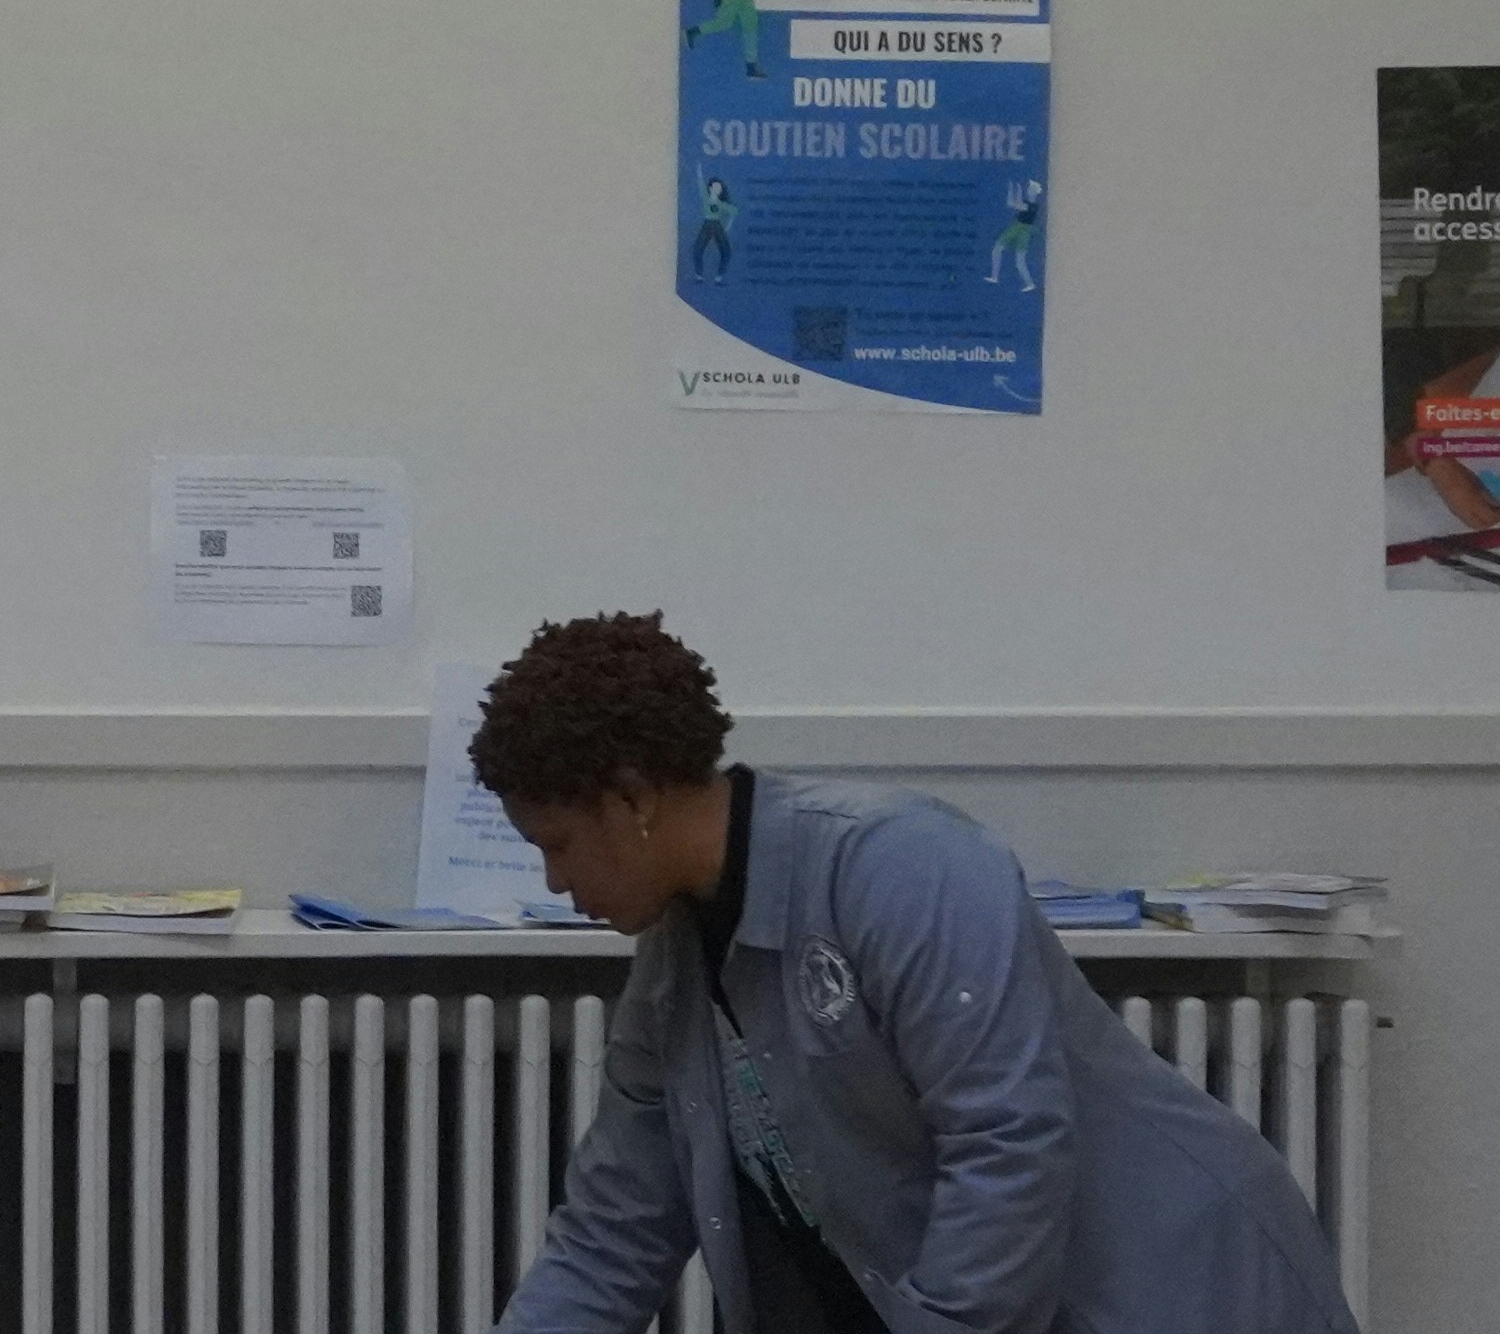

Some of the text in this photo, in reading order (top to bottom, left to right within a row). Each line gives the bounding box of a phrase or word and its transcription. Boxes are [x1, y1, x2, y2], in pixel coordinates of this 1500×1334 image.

[833, 30, 1003, 54] QUI A DU SENS ?
[793, 77, 936, 109] DONNE DU
[702, 119, 1026, 161] SOUTIEN SCOLAIRE
[854, 345, 1017, 363] www.schola-ulb.be
[702, 372, 800, 385] SCHOLA ULB
